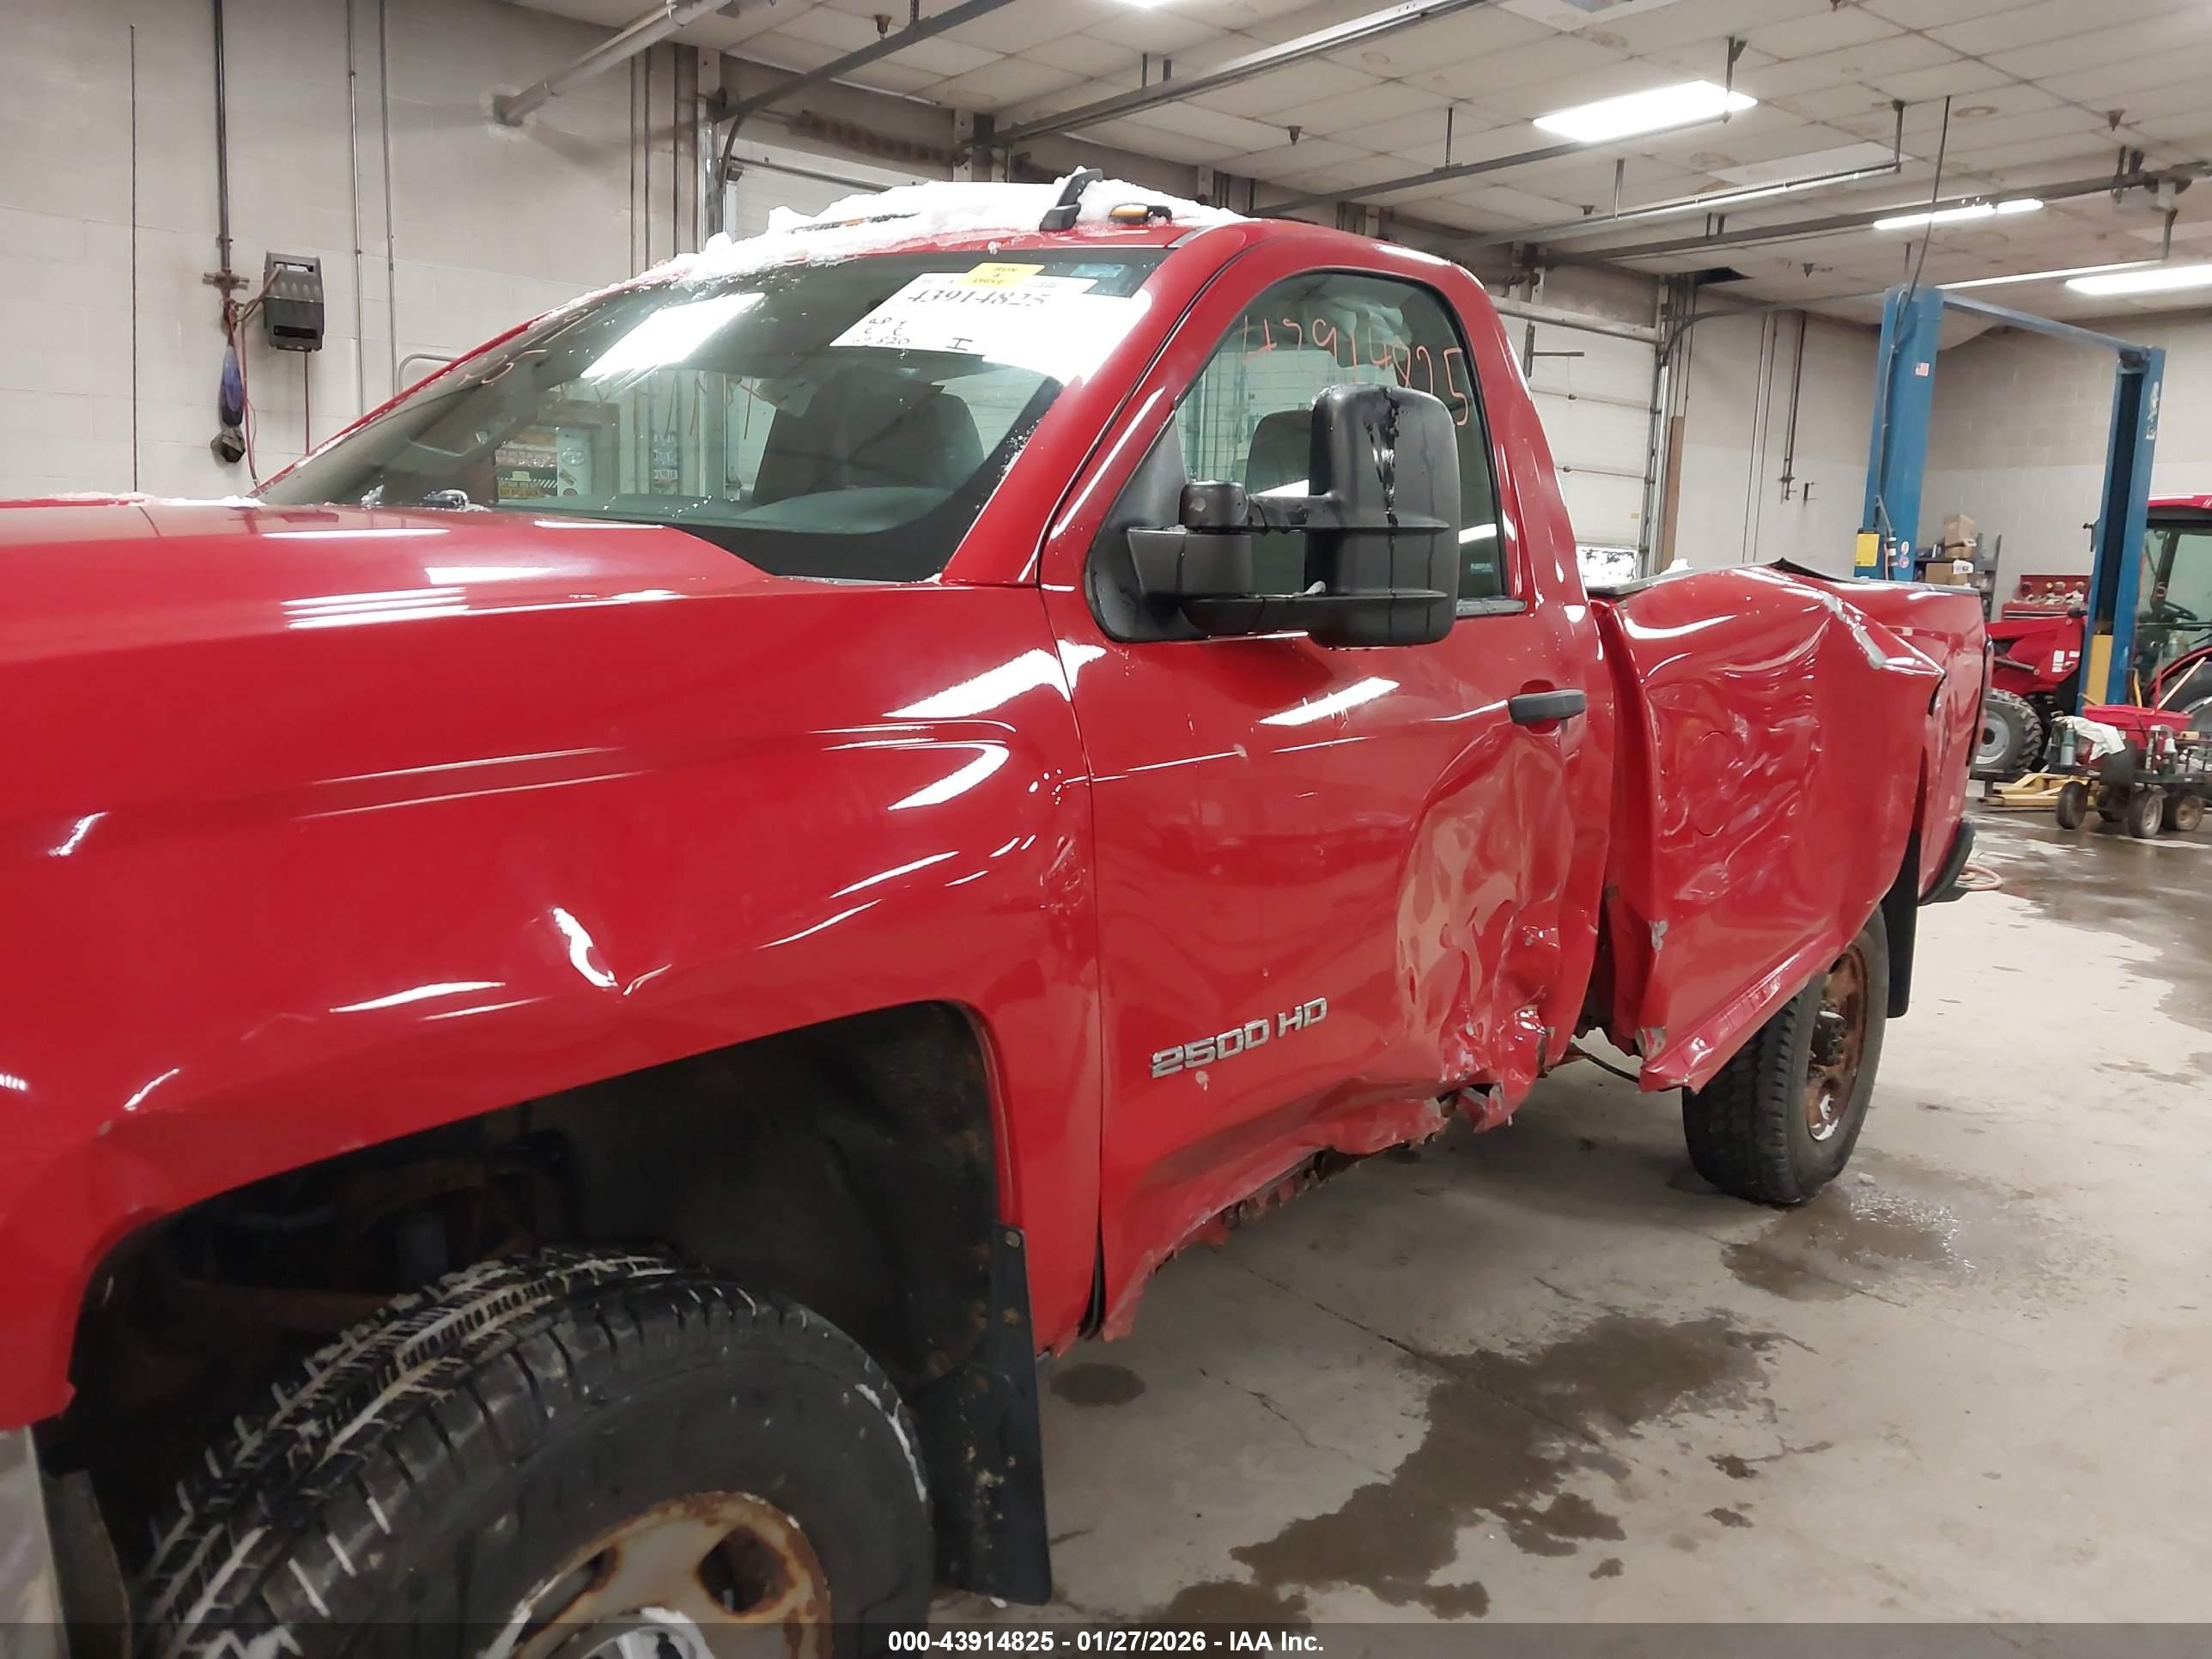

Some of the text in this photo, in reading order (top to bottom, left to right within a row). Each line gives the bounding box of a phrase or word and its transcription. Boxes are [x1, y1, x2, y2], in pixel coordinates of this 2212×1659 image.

[907, 289, 1048, 307] 43914825
[1151, 996, 1329, 1079] 2500 HD
